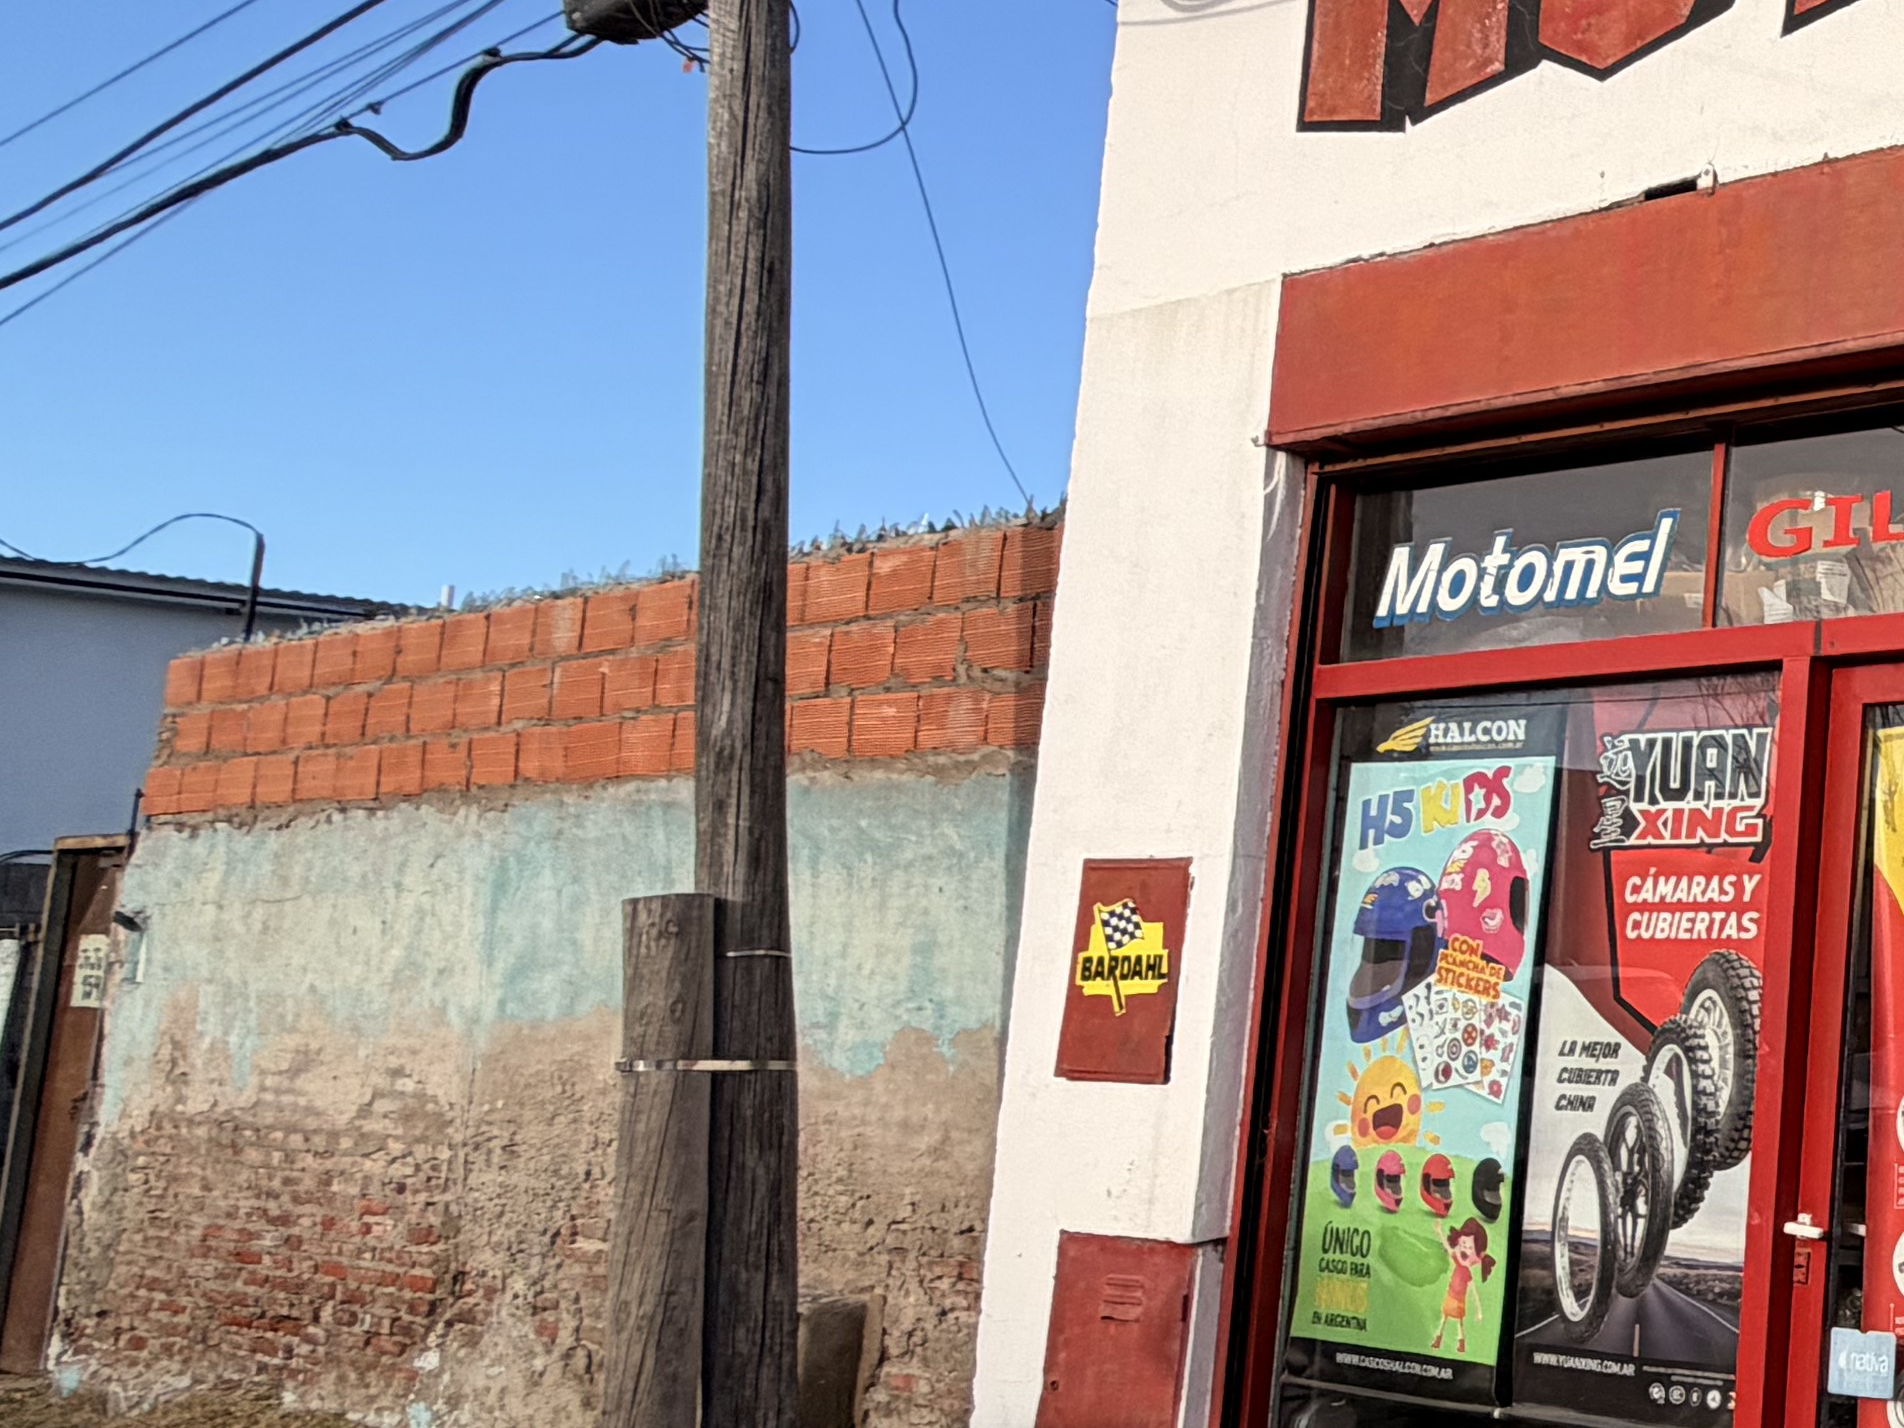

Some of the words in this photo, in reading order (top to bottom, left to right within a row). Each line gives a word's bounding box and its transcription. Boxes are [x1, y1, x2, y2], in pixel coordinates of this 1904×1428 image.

[1372, 509, 1681, 629] Motomel
[1428, 718, 1527, 743] HALCON
[1628, 728, 1774, 805] YUAN
[1419, 764, 1514, 835] KIDS
[1630, 803, 1767, 845] XING
[1624, 867, 1737, 905] CÁMARAS
[1738, 874, 1763, 903] Y
[1624, 911, 1761, 940] CUBIERTAS
[1450, 935, 1482, 956] CON
[1079, 951, 1168, 983] BARDAHL
[1435, 966, 1502, 1001] STICKERS
[1557, 1040, 1578, 1058] LA
[1579, 1040, 1622, 1062] MEJOR
[1555, 1093, 1597, 1114] CHINA
[1321, 1220, 1372, 1260] ÚNICO
[1850, 1352, 1889, 1373] nativa
